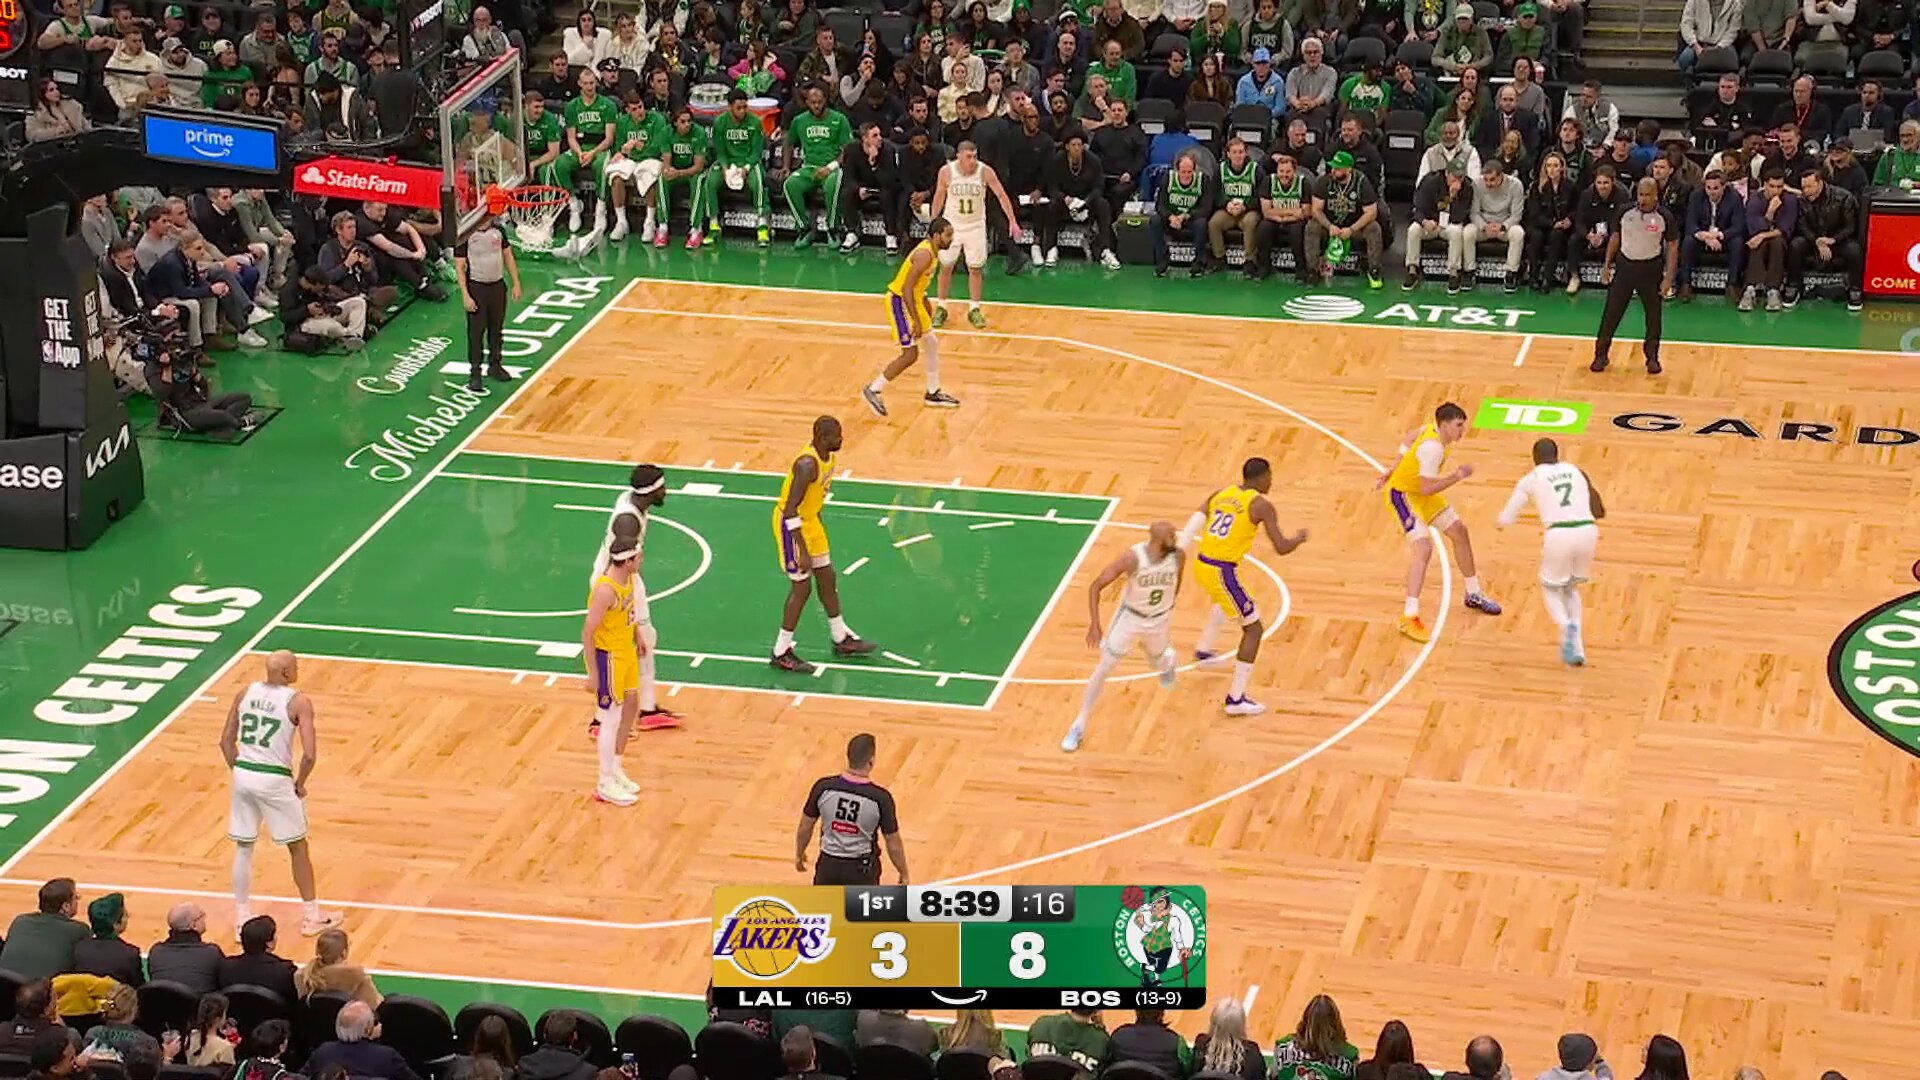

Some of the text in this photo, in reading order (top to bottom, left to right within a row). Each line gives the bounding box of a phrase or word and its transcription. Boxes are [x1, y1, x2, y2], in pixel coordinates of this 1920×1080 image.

[185, 128, 234, 147] prime
[959, 199, 974, 214] 11
[1871, 277, 1917, 289] COME
[44, 297, 70, 320] GET
[502, 276, 614, 357] ULTRA
[1374, 303, 1536, 327] AT&T
[45, 319, 73, 341] THE
[54, 341, 80, 368] App
[1491, 404, 1920, 446] TD GARD
[1553, 483, 1573, 508] 7
[1209, 509, 1235, 538] 28
[1149, 589, 1164, 606] 9
[33, 584, 263, 726] CELTICS
[240, 712, 282, 749] 27
[835, 797, 860, 822] 53
